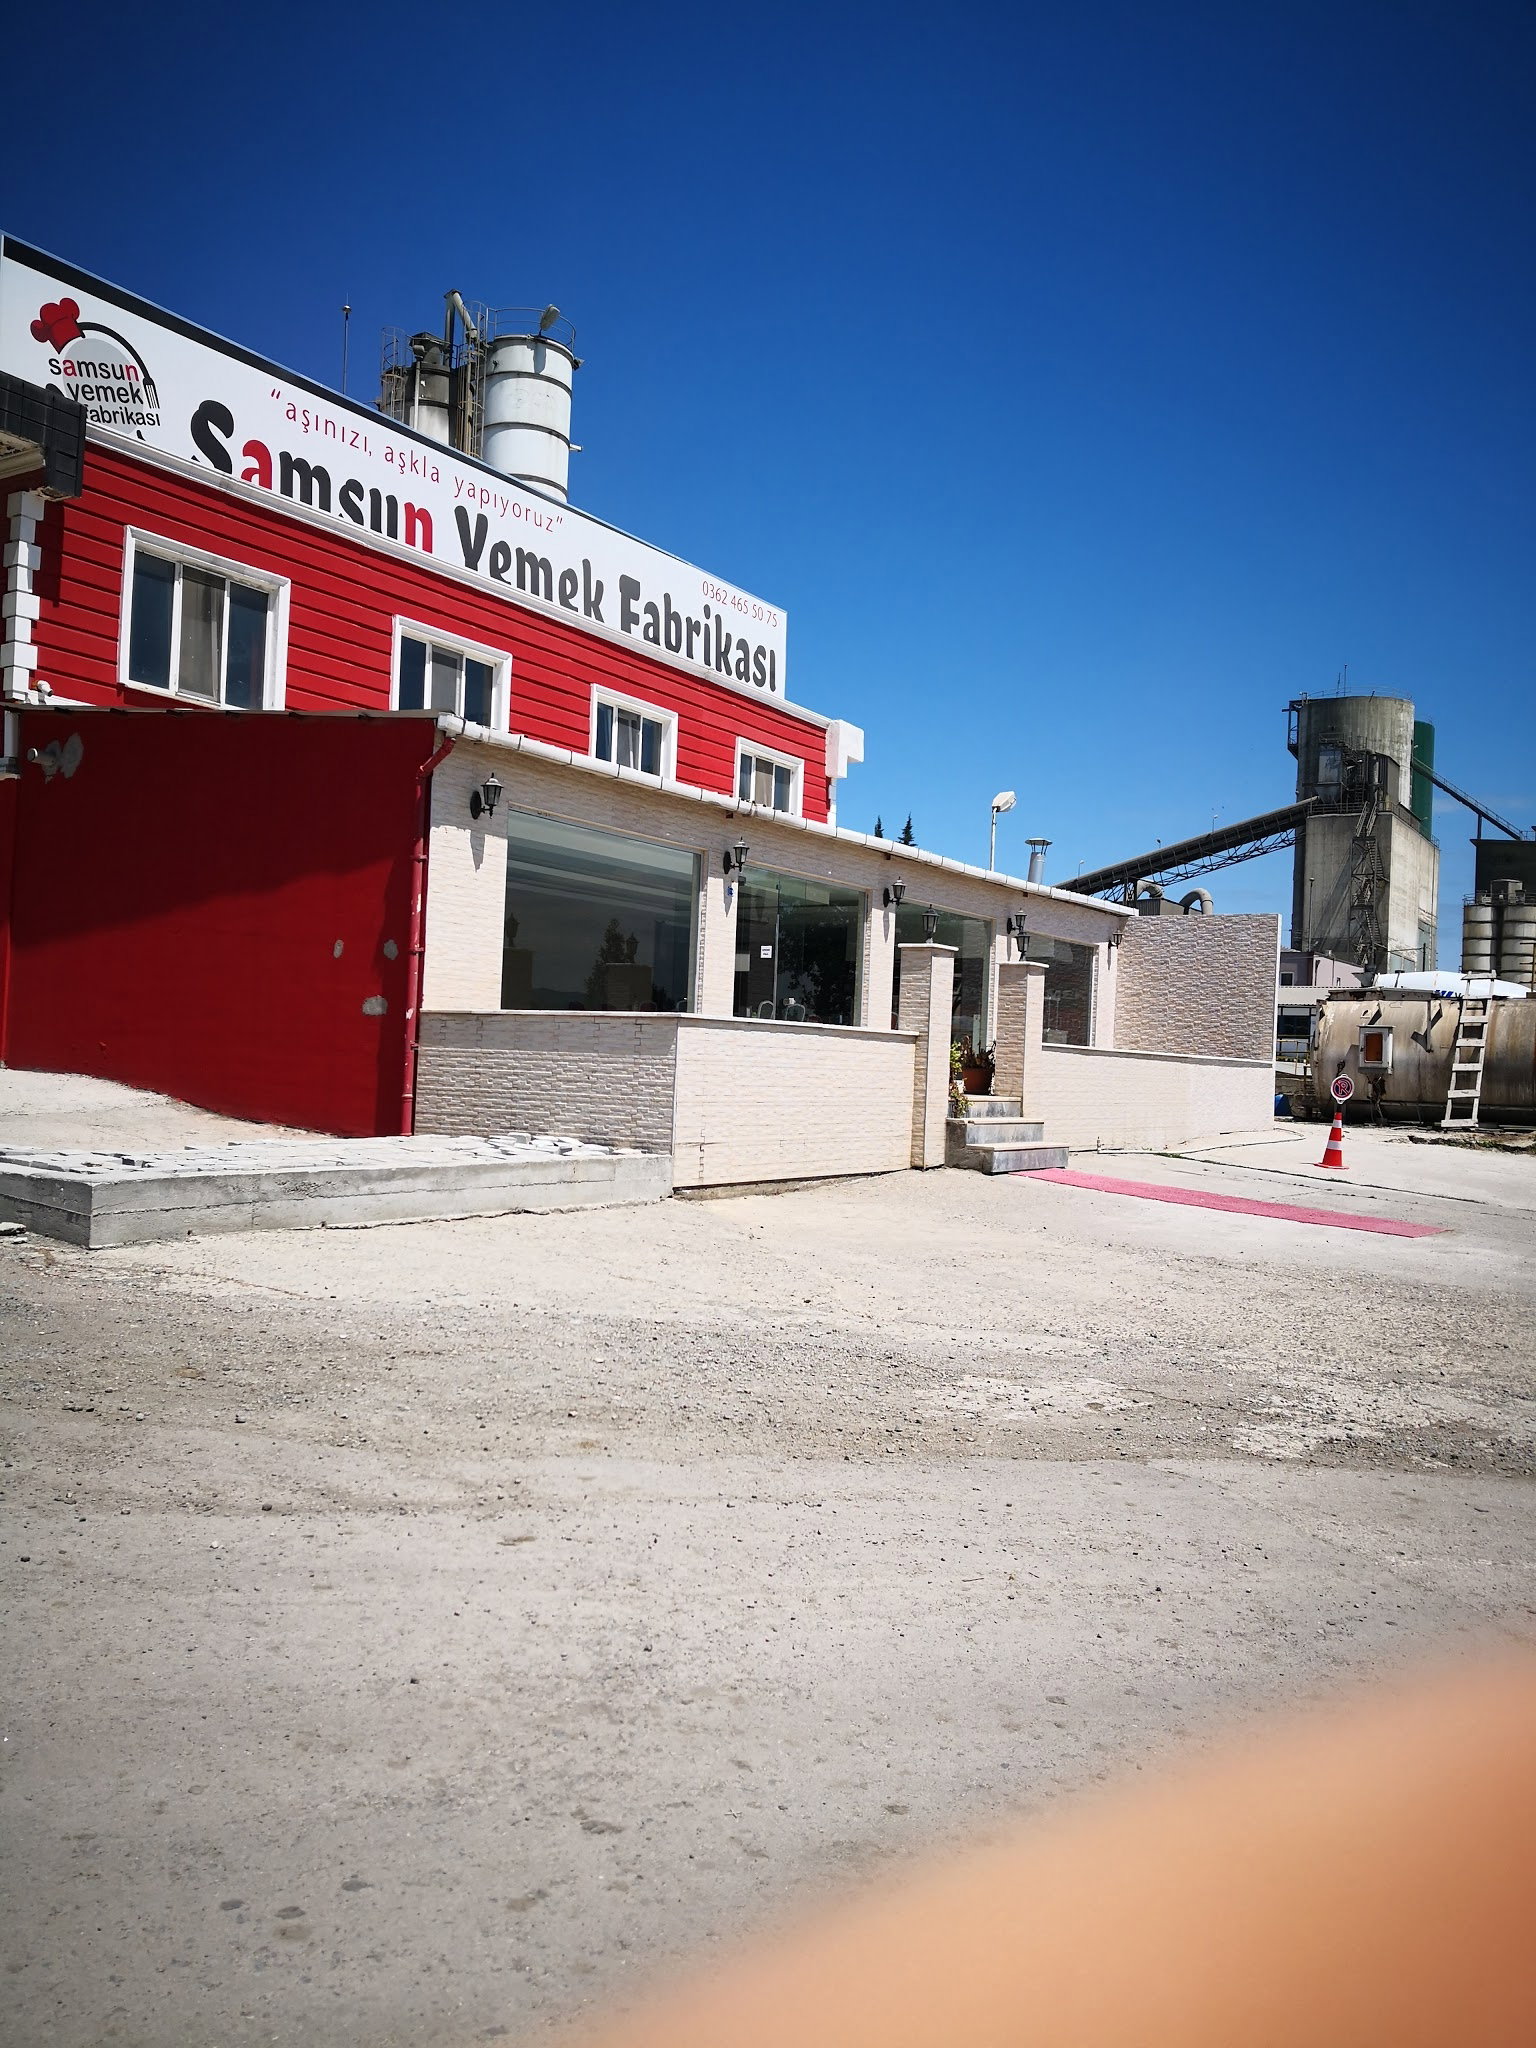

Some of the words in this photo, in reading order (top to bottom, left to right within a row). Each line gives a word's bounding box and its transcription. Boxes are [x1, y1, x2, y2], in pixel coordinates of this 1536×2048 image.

[48, 358, 140, 382] samsun
[66, 382, 144, 405] yemek
[384, 446, 440, 483] aşkla
[190, 399, 434, 554] Samsun
[453, 505, 605, 623] Yemek
[618, 574, 777, 692] Fabrikası
[702, 580, 728, 606] 0362
[730, 595, 749, 615] 465
[752, 603, 764, 622] 50
[766, 610, 778, 628] 75
